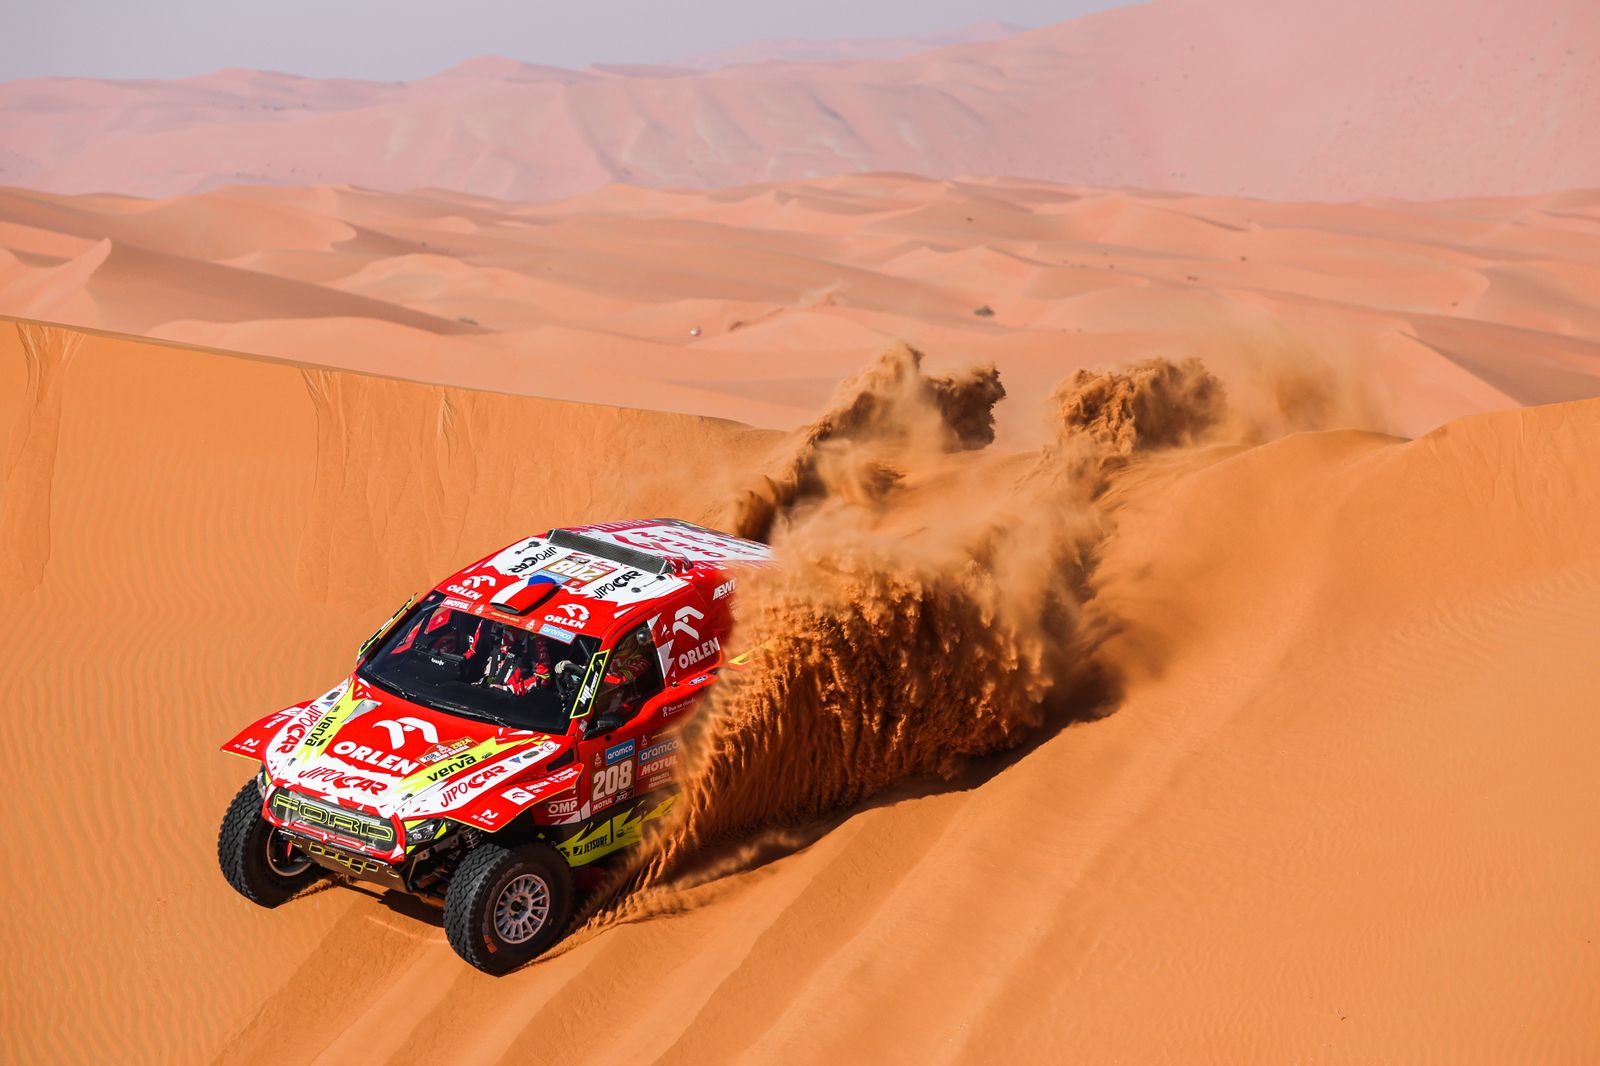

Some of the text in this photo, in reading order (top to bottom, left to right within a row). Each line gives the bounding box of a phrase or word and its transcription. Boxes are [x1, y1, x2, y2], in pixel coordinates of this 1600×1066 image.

[446, 584, 483, 601] ORLEN
[593, 570, 643, 600] JIPOCAR
[443, 598, 470, 610] MOTUL
[543, 626, 573, 640] aramco
[544, 614, 587, 630] ORLEN
[678, 637, 721, 670] ORLEN
[304, 716, 337, 747] verva
[333, 740, 420, 775] ORLEN
[607, 744, 634, 760] aramco
[640, 739, 680, 761] aramco
[427, 755, 477, 782] verva
[641, 755, 678, 777] MOTUL
[592, 760, 633, 801] 208
[548, 800, 578, 814] OMP
[592, 797, 613, 811] MOTUL
[273, 793, 394, 843] FORD
[583, 834, 608, 854] JETSURF
